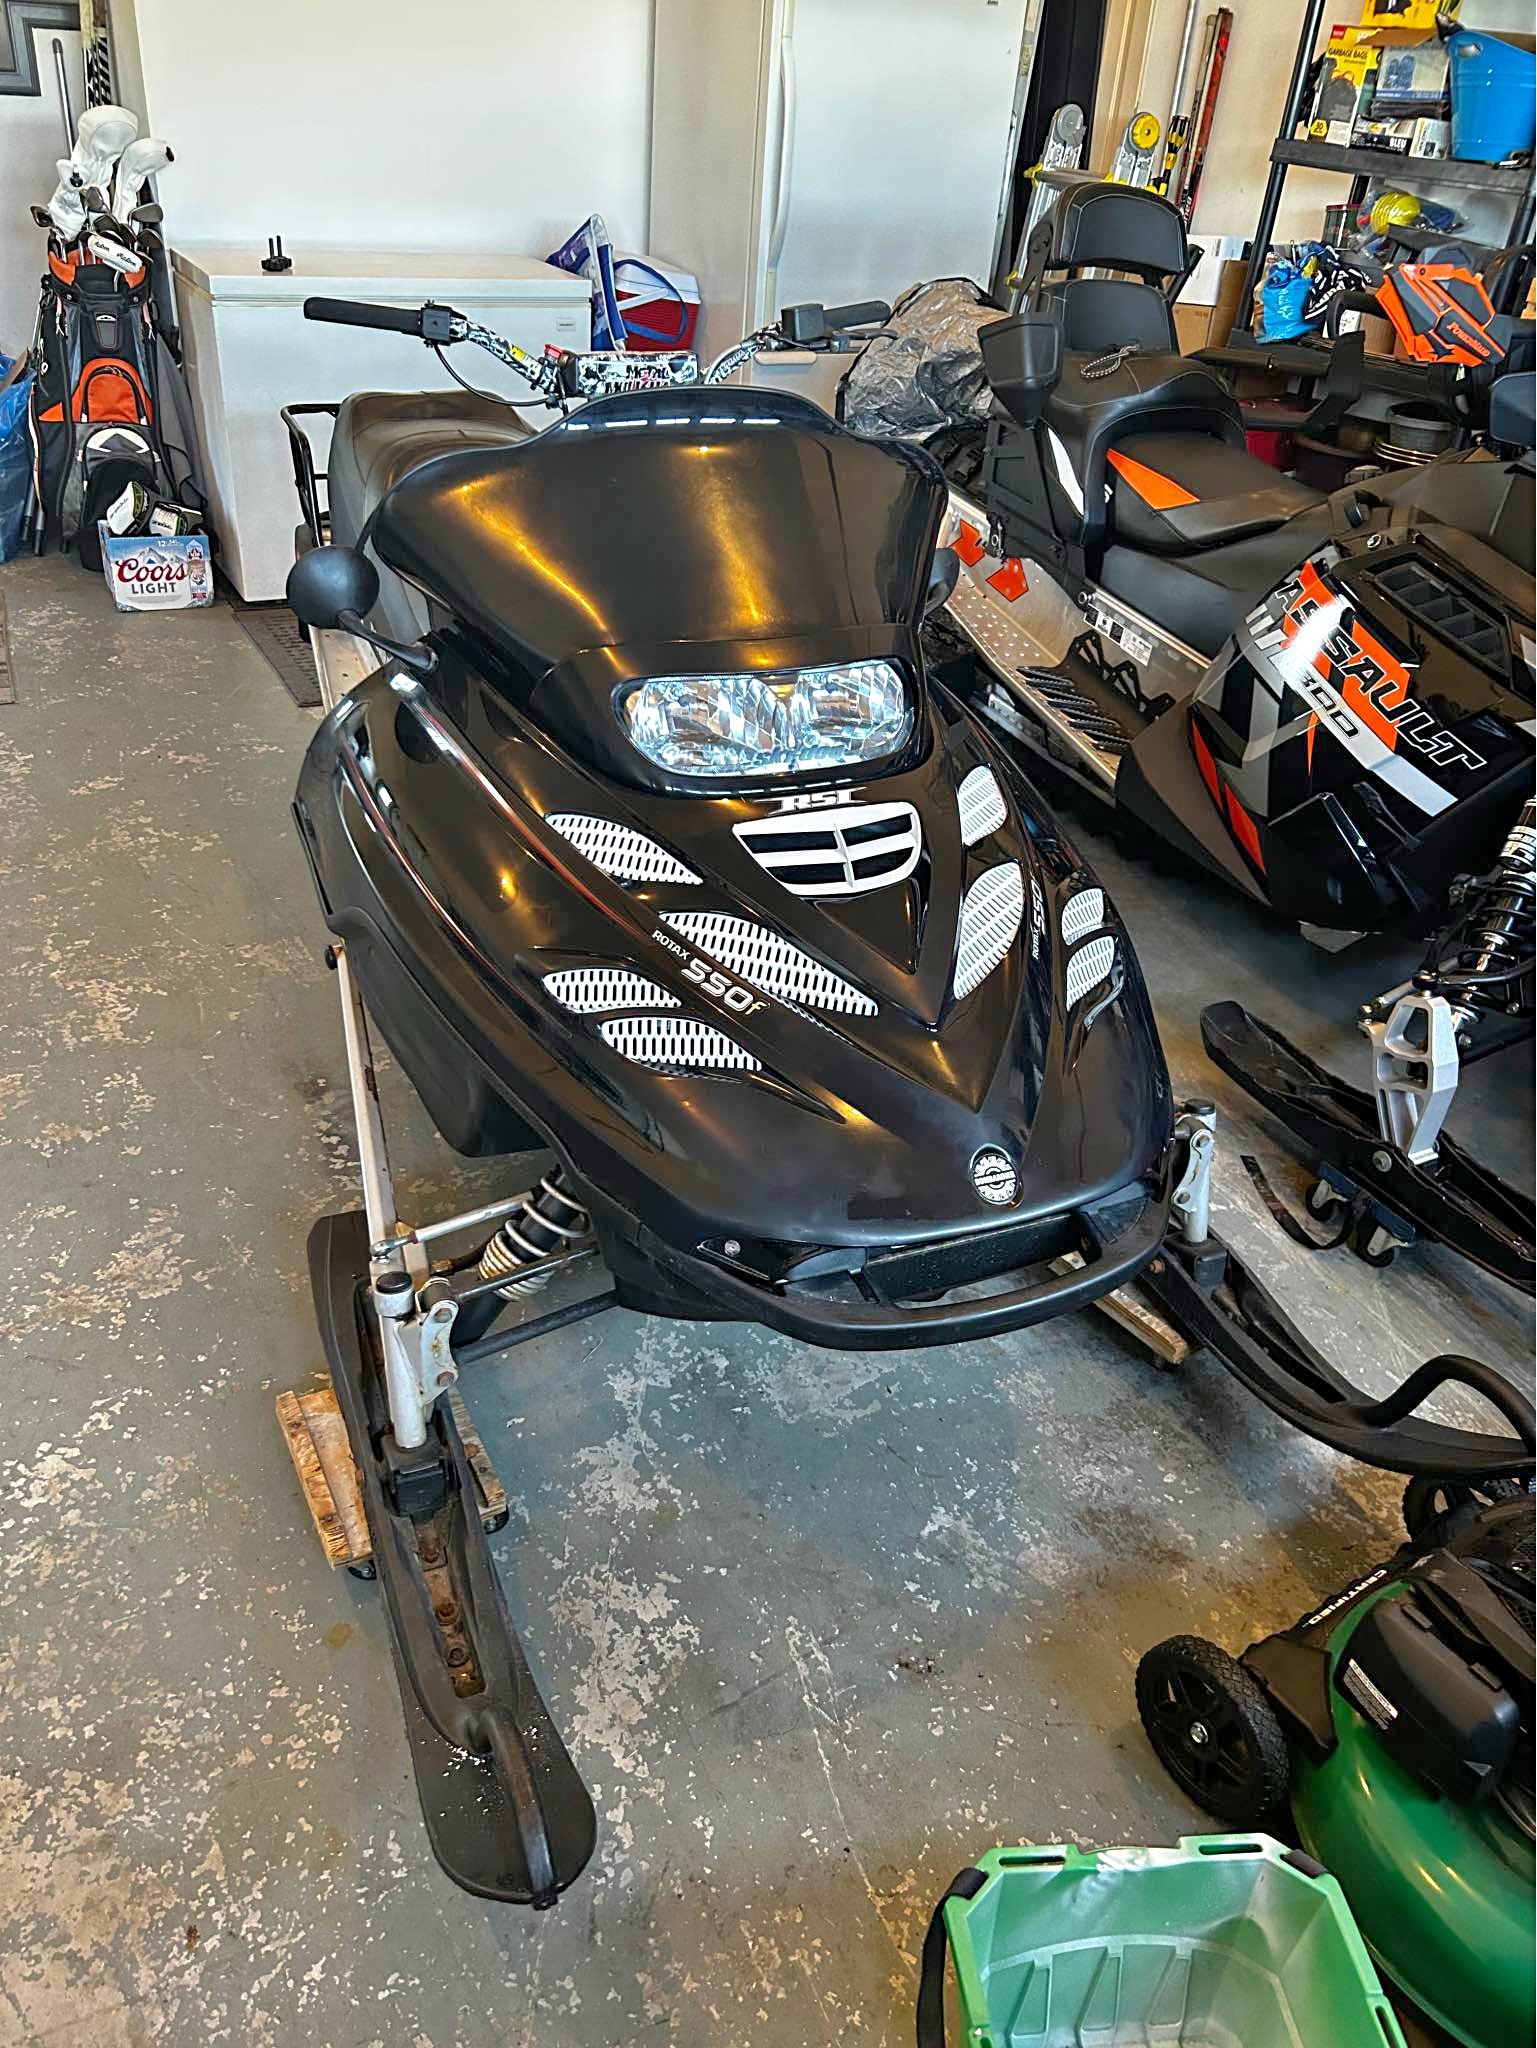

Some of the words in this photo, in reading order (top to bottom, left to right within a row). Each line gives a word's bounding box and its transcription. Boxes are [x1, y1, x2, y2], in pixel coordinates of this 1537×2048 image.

[1328, 48, 1352, 57] GARBAGE
[1389, 137, 1407, 148] BLEU
[116, 558, 188, 583] Coors
[131, 582, 177, 595] LIGHT
[652, 929, 691, 960] ROTAX
[1307, 1569, 1388, 1625] CERTIFIED
